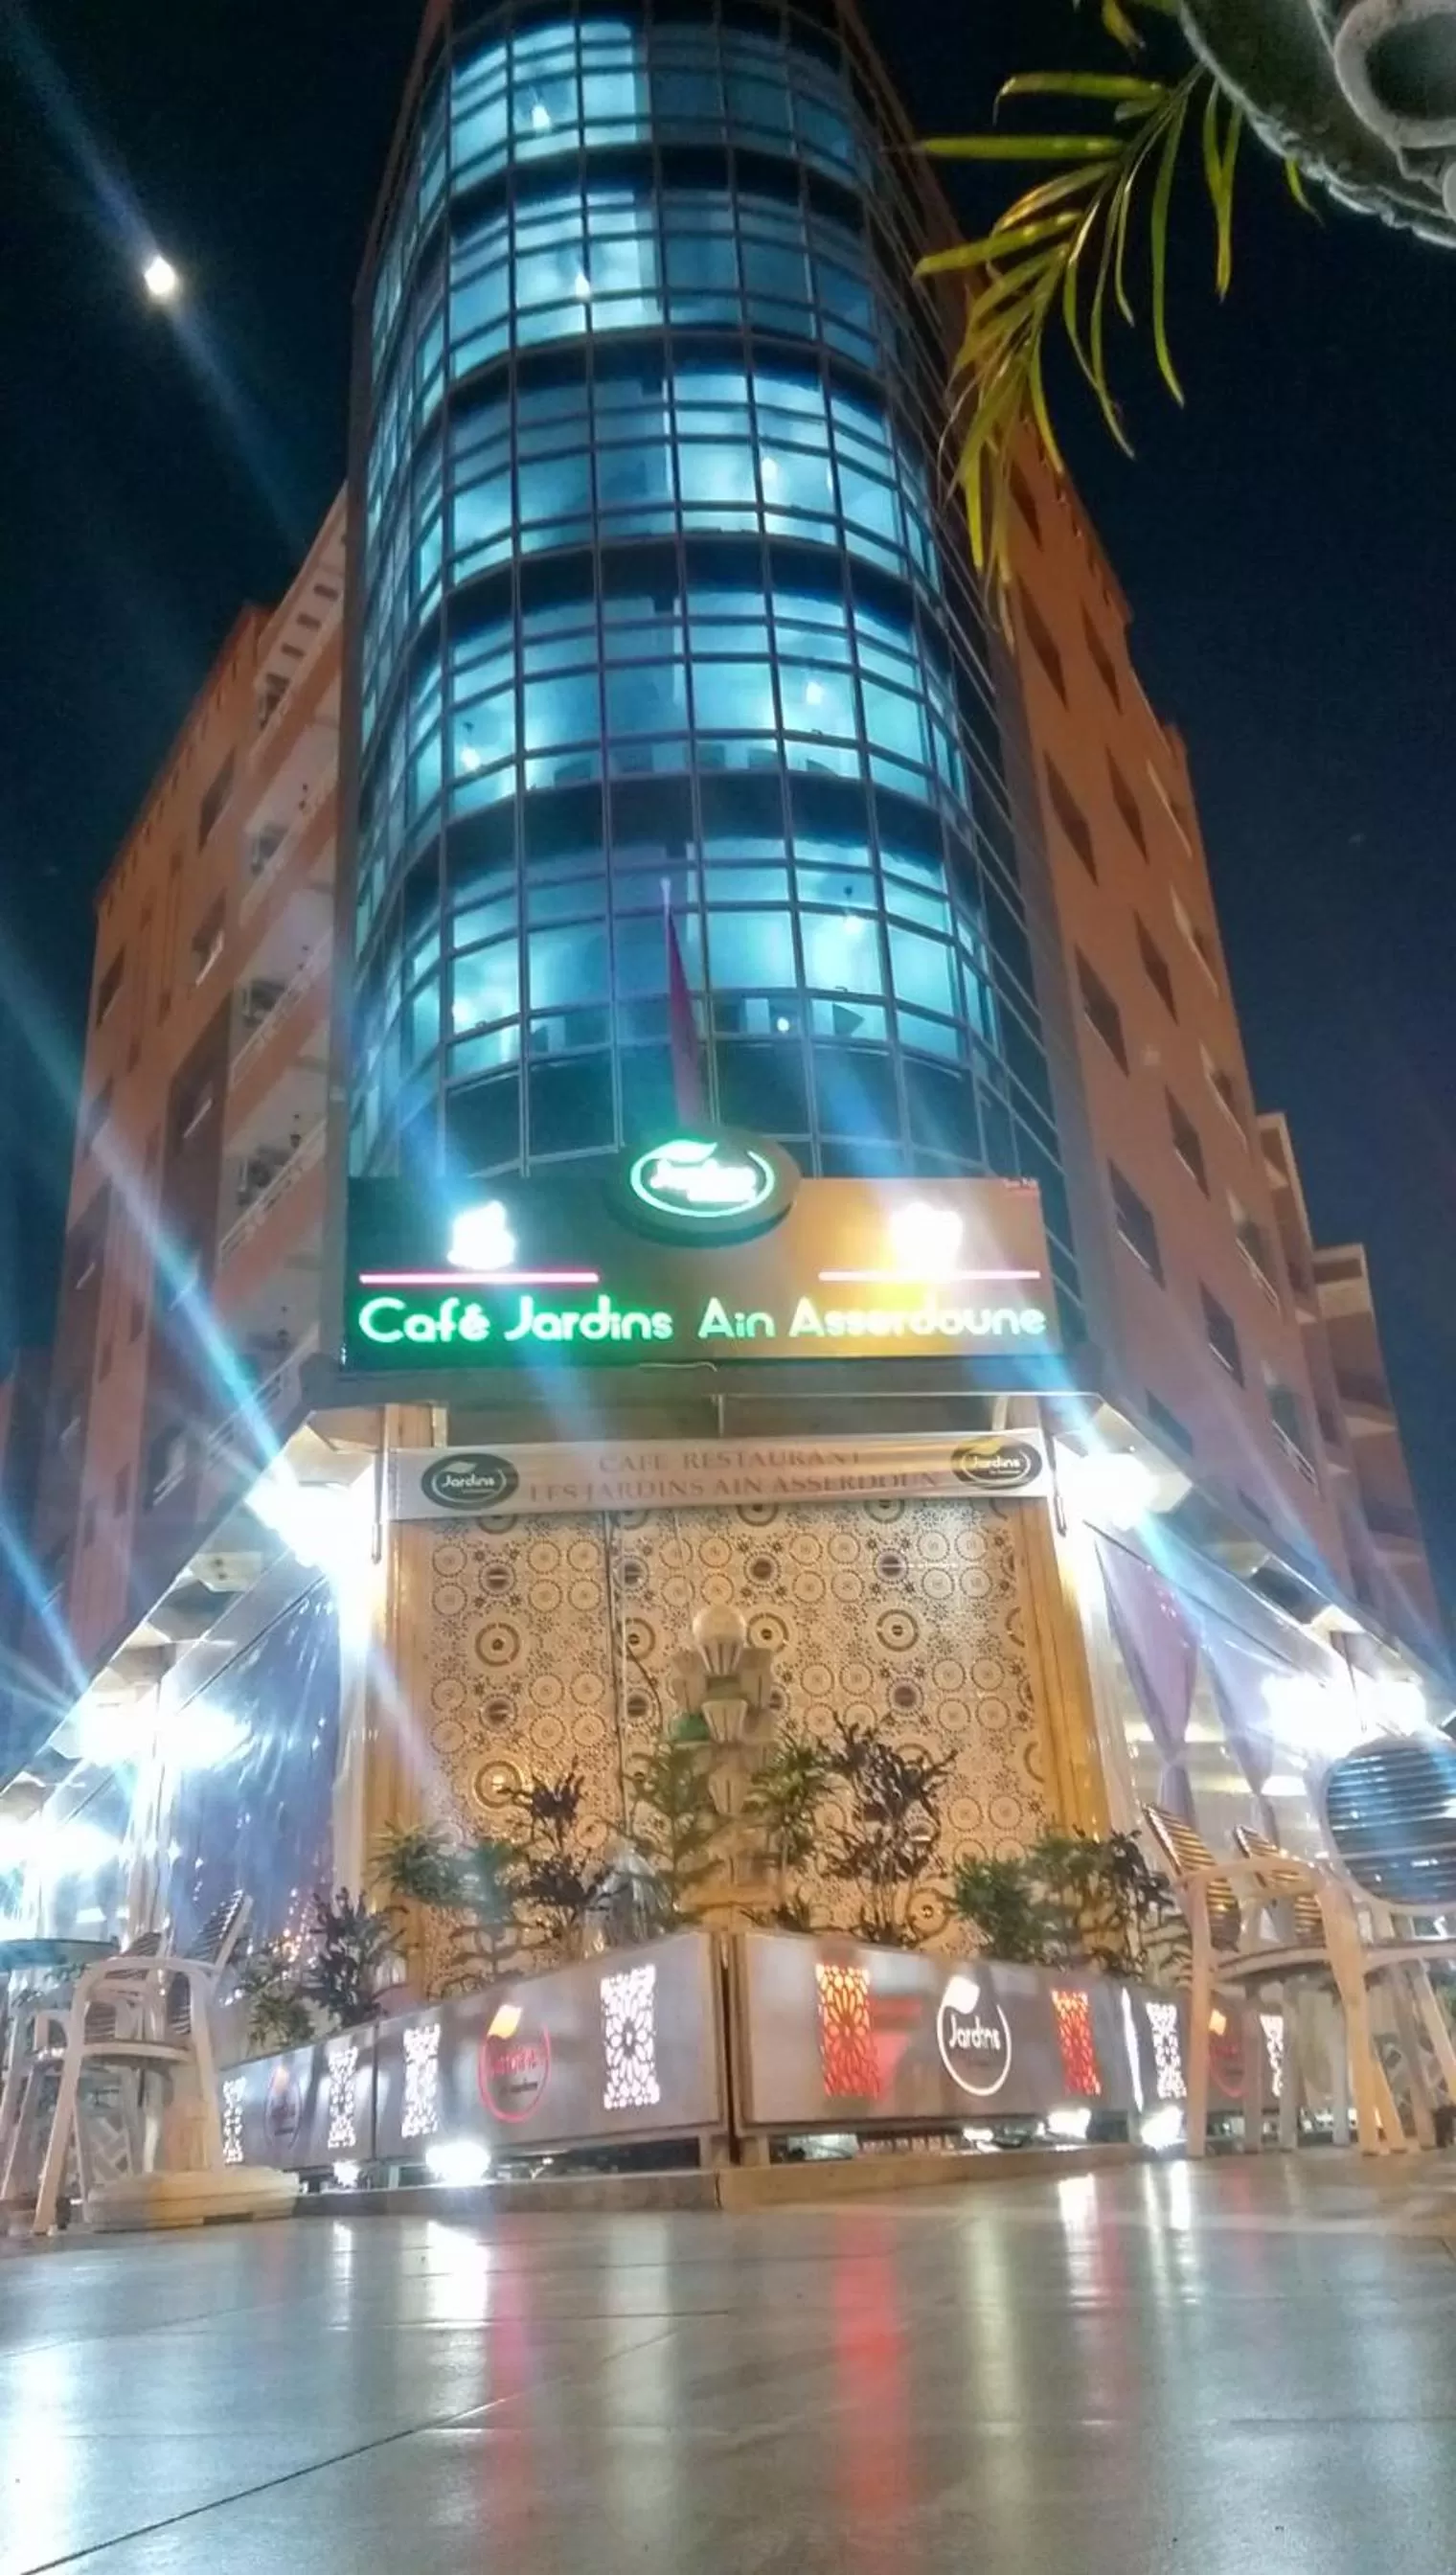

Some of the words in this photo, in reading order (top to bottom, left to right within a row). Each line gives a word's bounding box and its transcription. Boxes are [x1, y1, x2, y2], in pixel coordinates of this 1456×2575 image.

[358, 1296, 491, 1342] Café
[504, 1294, 672, 1340] Jardins
[697, 1296, 776, 1338] Ain
[788, 1293, 1047, 1337] Asserdoune
[681, 1448, 863, 1470] RESTAURANT
[441, 1472, 495, 1488] Jardins
[528, 1482, 578, 1503] LES
[585, 1478, 705, 1503] JARDINS
[712, 1474, 763, 1496] AIN
[948, 2014, 1001, 2050] Jardins
